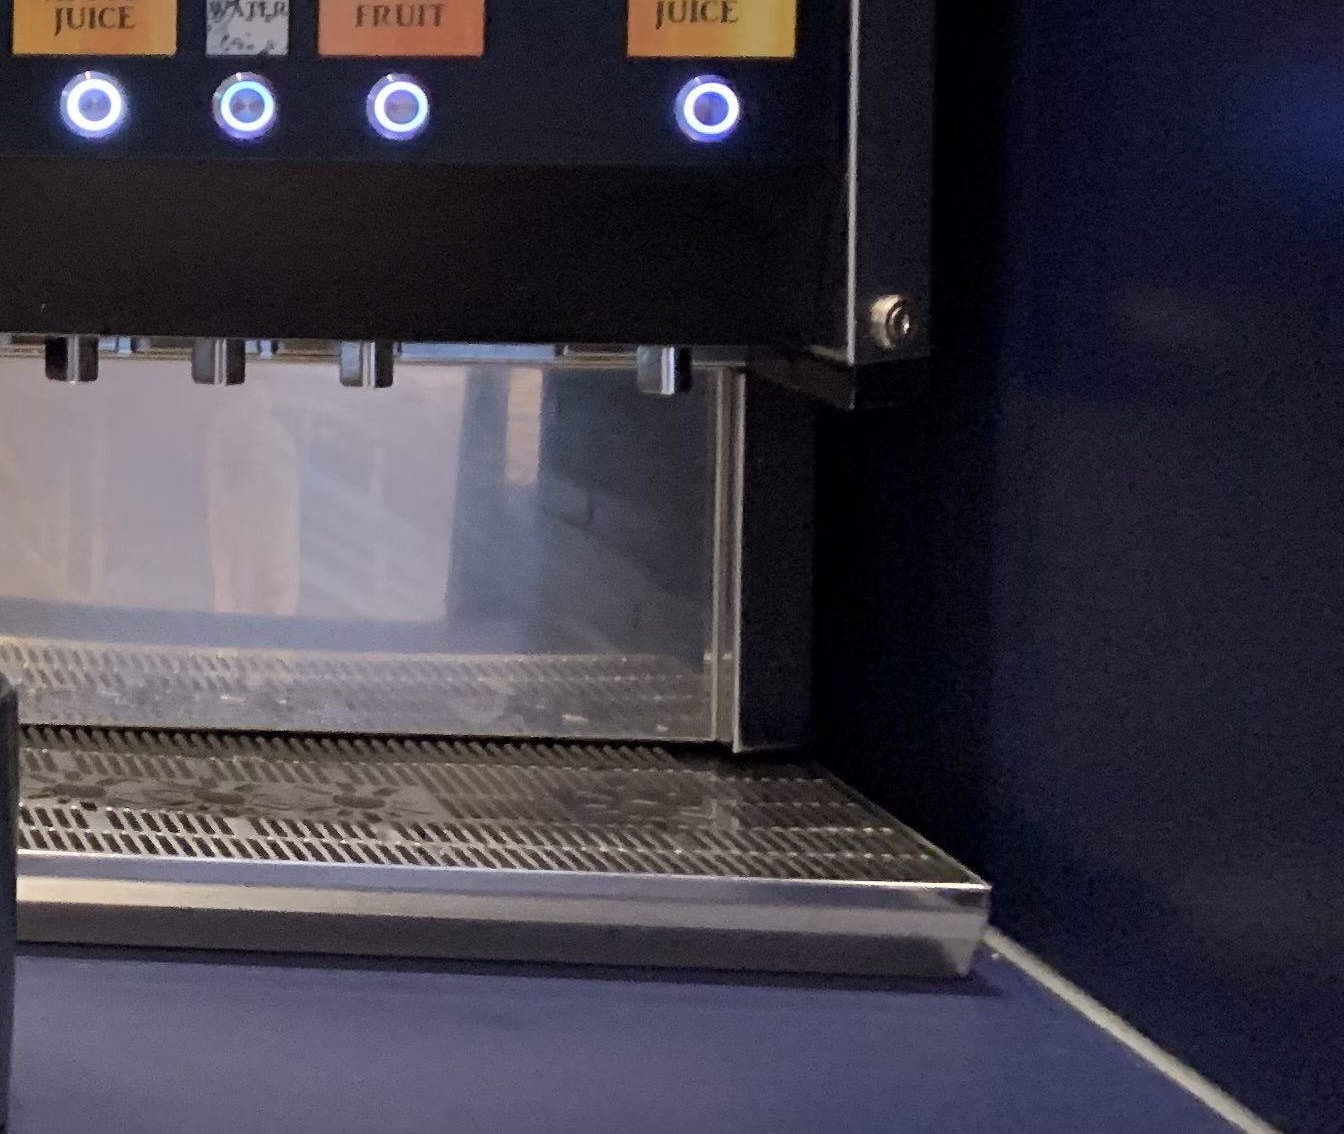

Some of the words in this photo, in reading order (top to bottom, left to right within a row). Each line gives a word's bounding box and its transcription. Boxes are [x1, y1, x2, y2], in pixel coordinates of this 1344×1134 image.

[53, 5, 137, 37] JUICE
[208, 0, 290, 24] WATER
[354, 2, 446, 29] FRUIT
